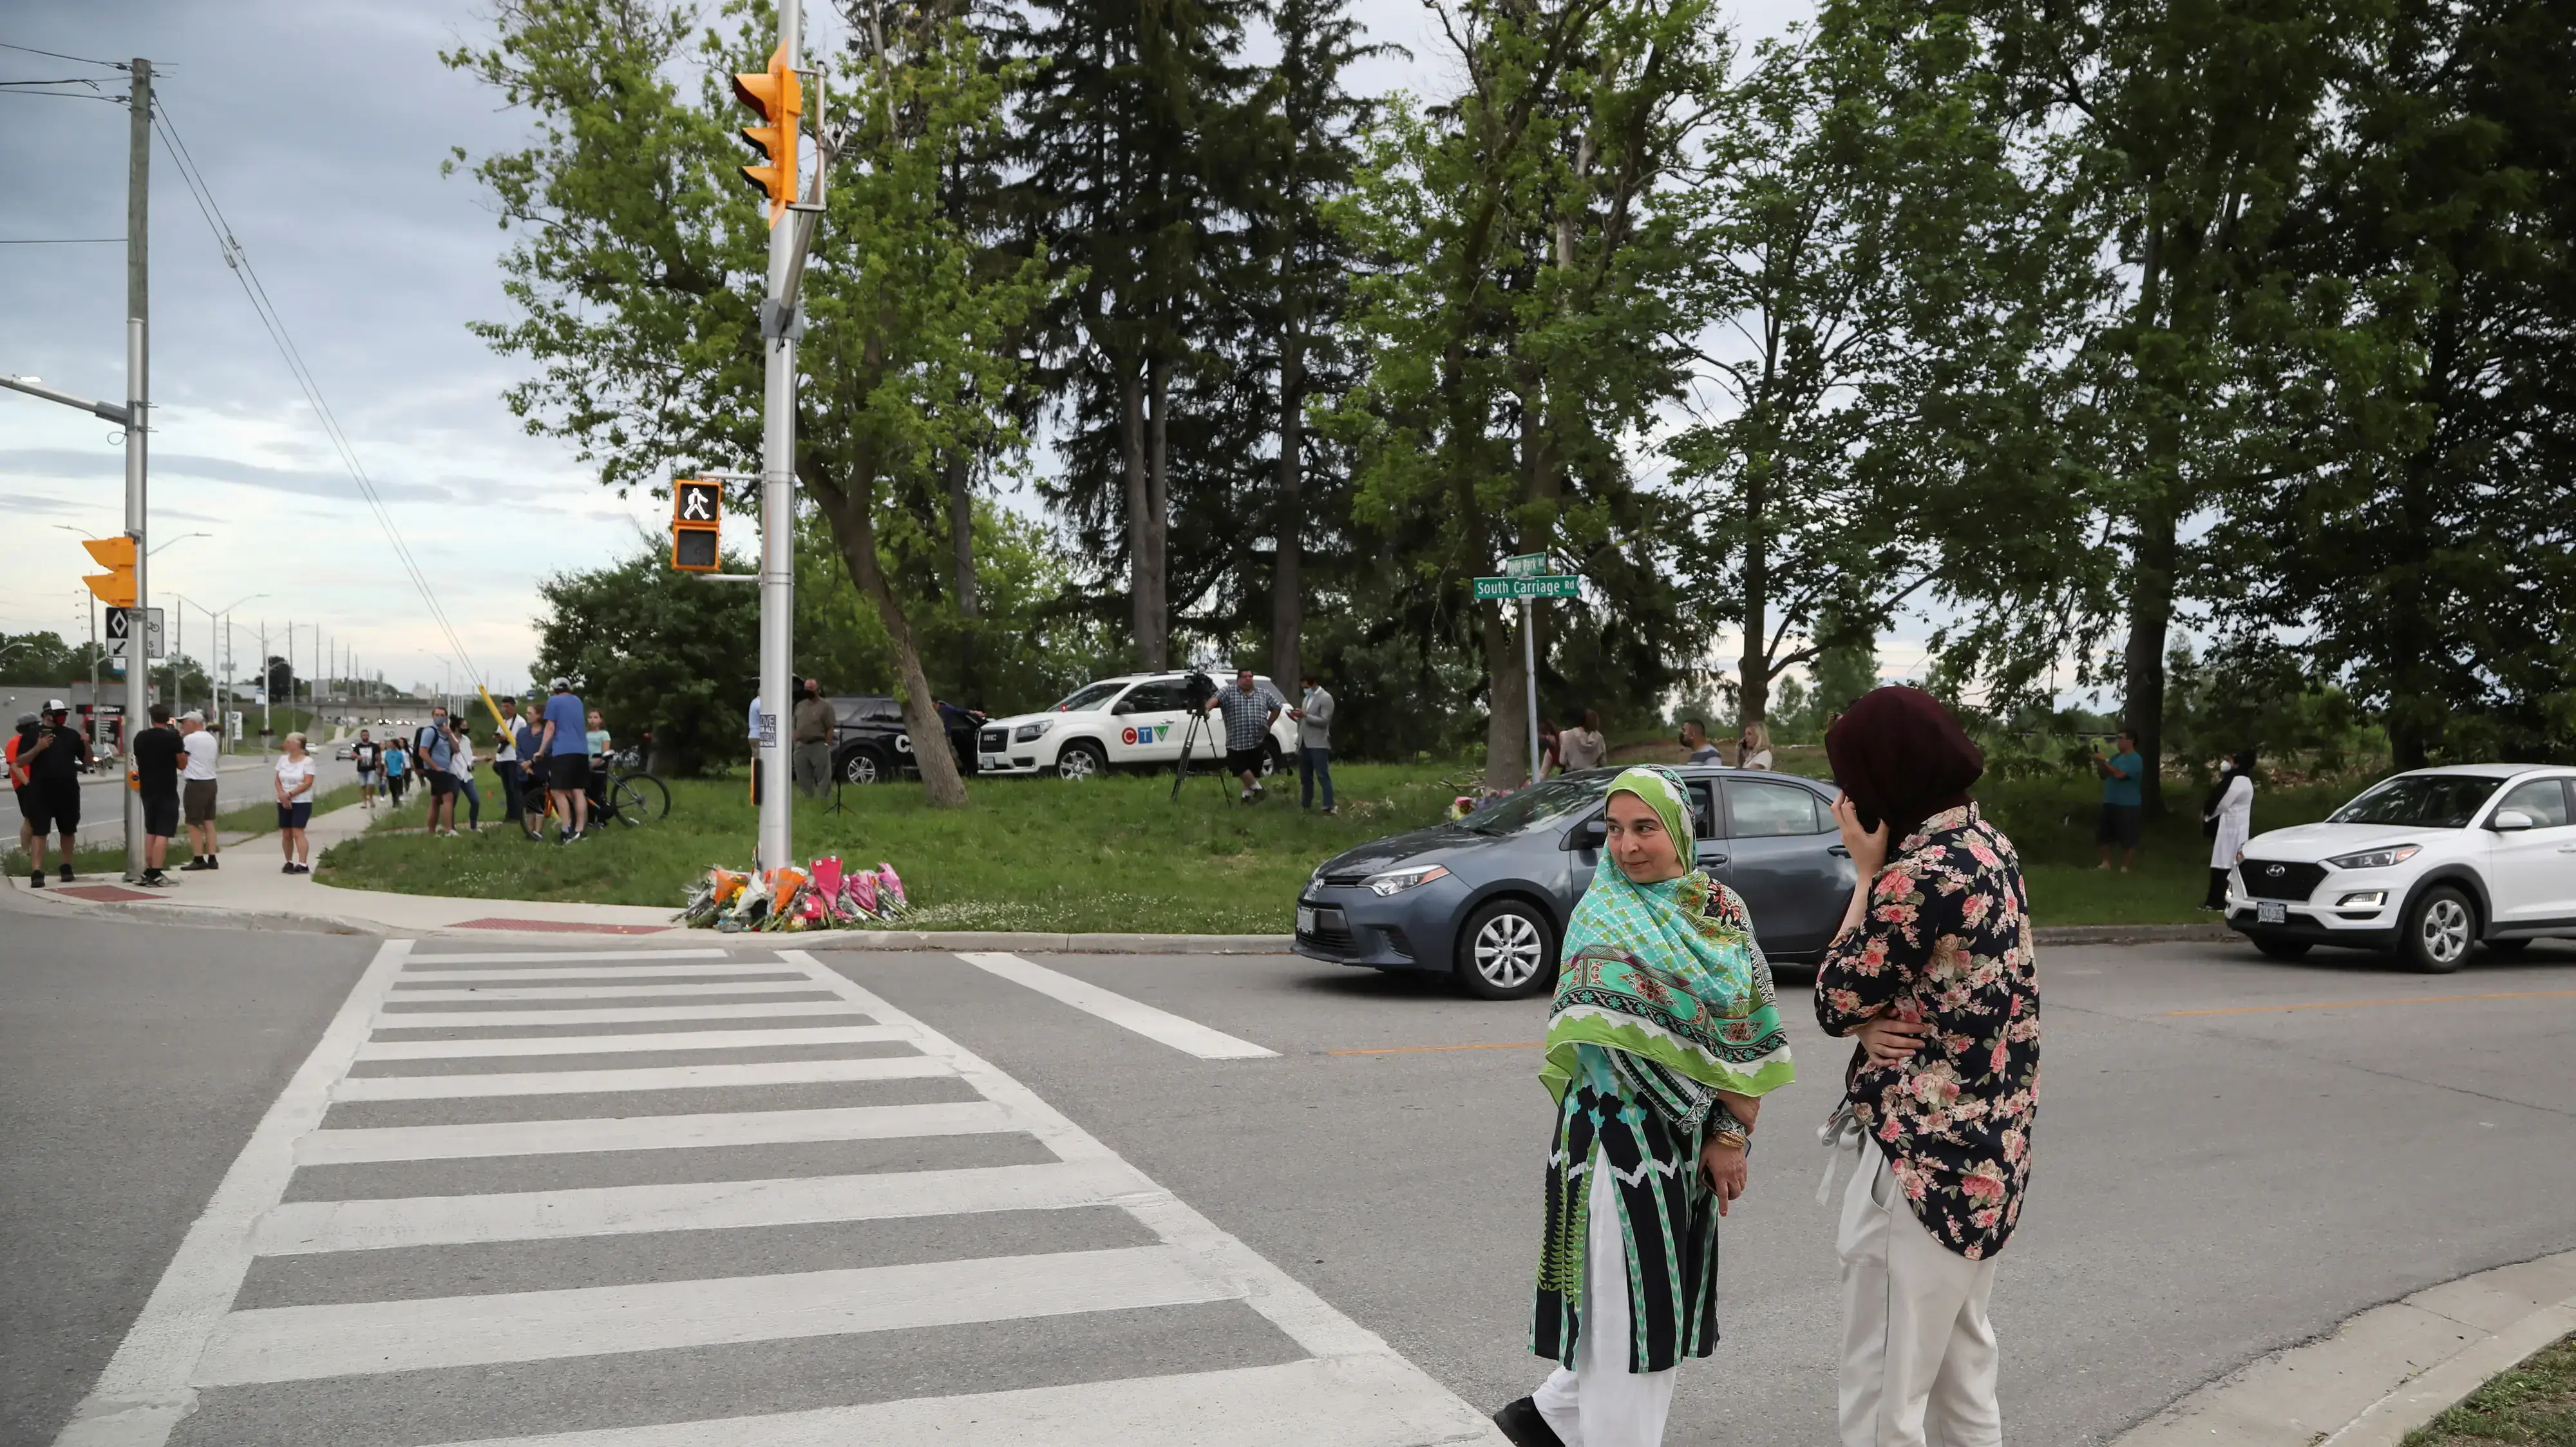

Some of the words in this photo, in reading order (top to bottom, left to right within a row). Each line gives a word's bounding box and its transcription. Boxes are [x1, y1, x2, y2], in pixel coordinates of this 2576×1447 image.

[1507, 560, 1522, 576] Hyde
[1523, 557, 1537, 572] Park
[1478, 581, 1509, 594] South
[1514, 580, 1560, 596] Carriage
[1565, 580, 1575, 589] Rd
[760, 715, 775, 727] OVE
[1122, 726, 1168, 743] CTV
